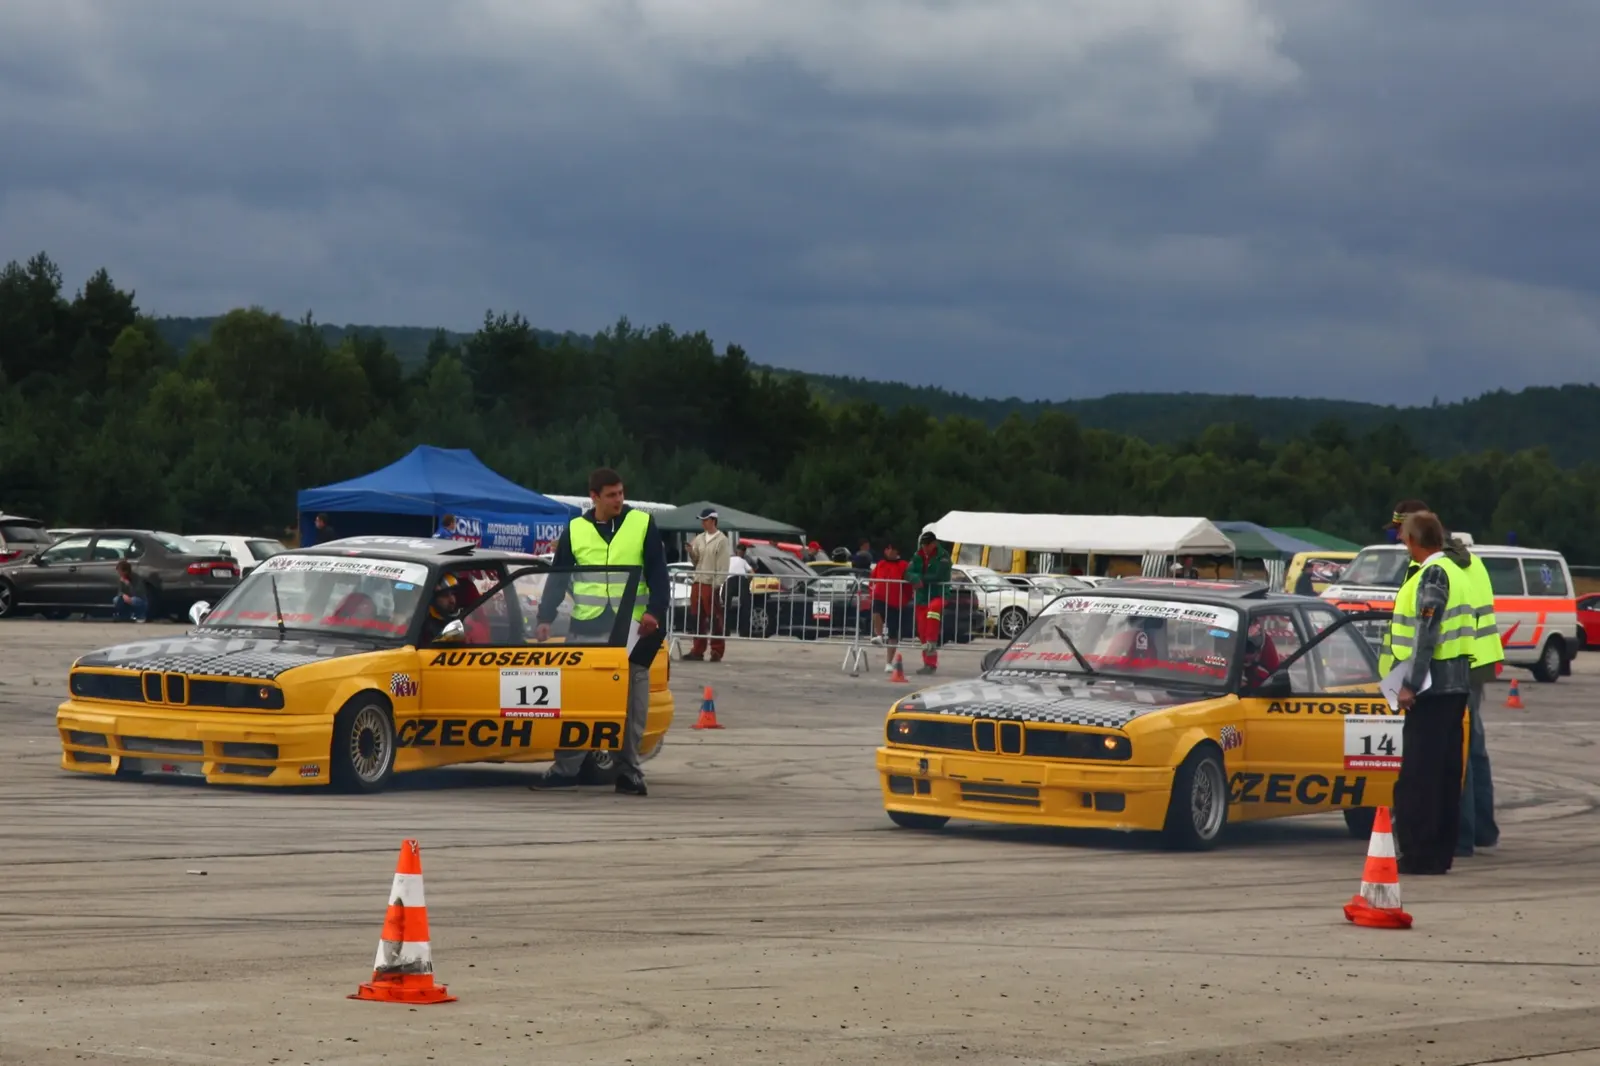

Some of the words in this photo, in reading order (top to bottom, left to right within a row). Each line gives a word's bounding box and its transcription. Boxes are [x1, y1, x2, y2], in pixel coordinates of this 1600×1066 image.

[453, 518, 480, 536] QUI
[536, 524, 564, 540] LIQU
[295, 560, 318, 568] KING
[334, 561, 371, 570] EUROPE
[373, 565, 406, 575] SERIES
[1093, 602, 1118, 610] KING
[1137, 605, 1182, 614] EUROPE
[1183, 608, 1219, 619] SERIES
[429, 651, 583, 666] AUTOSERVIS
[516, 685, 549, 706] 12
[396, 719, 533, 748] CZECH
[559, 721, 622, 749] DR
[1360, 733, 1396, 756] 14
[1228, 772, 1366, 805] CZECH
